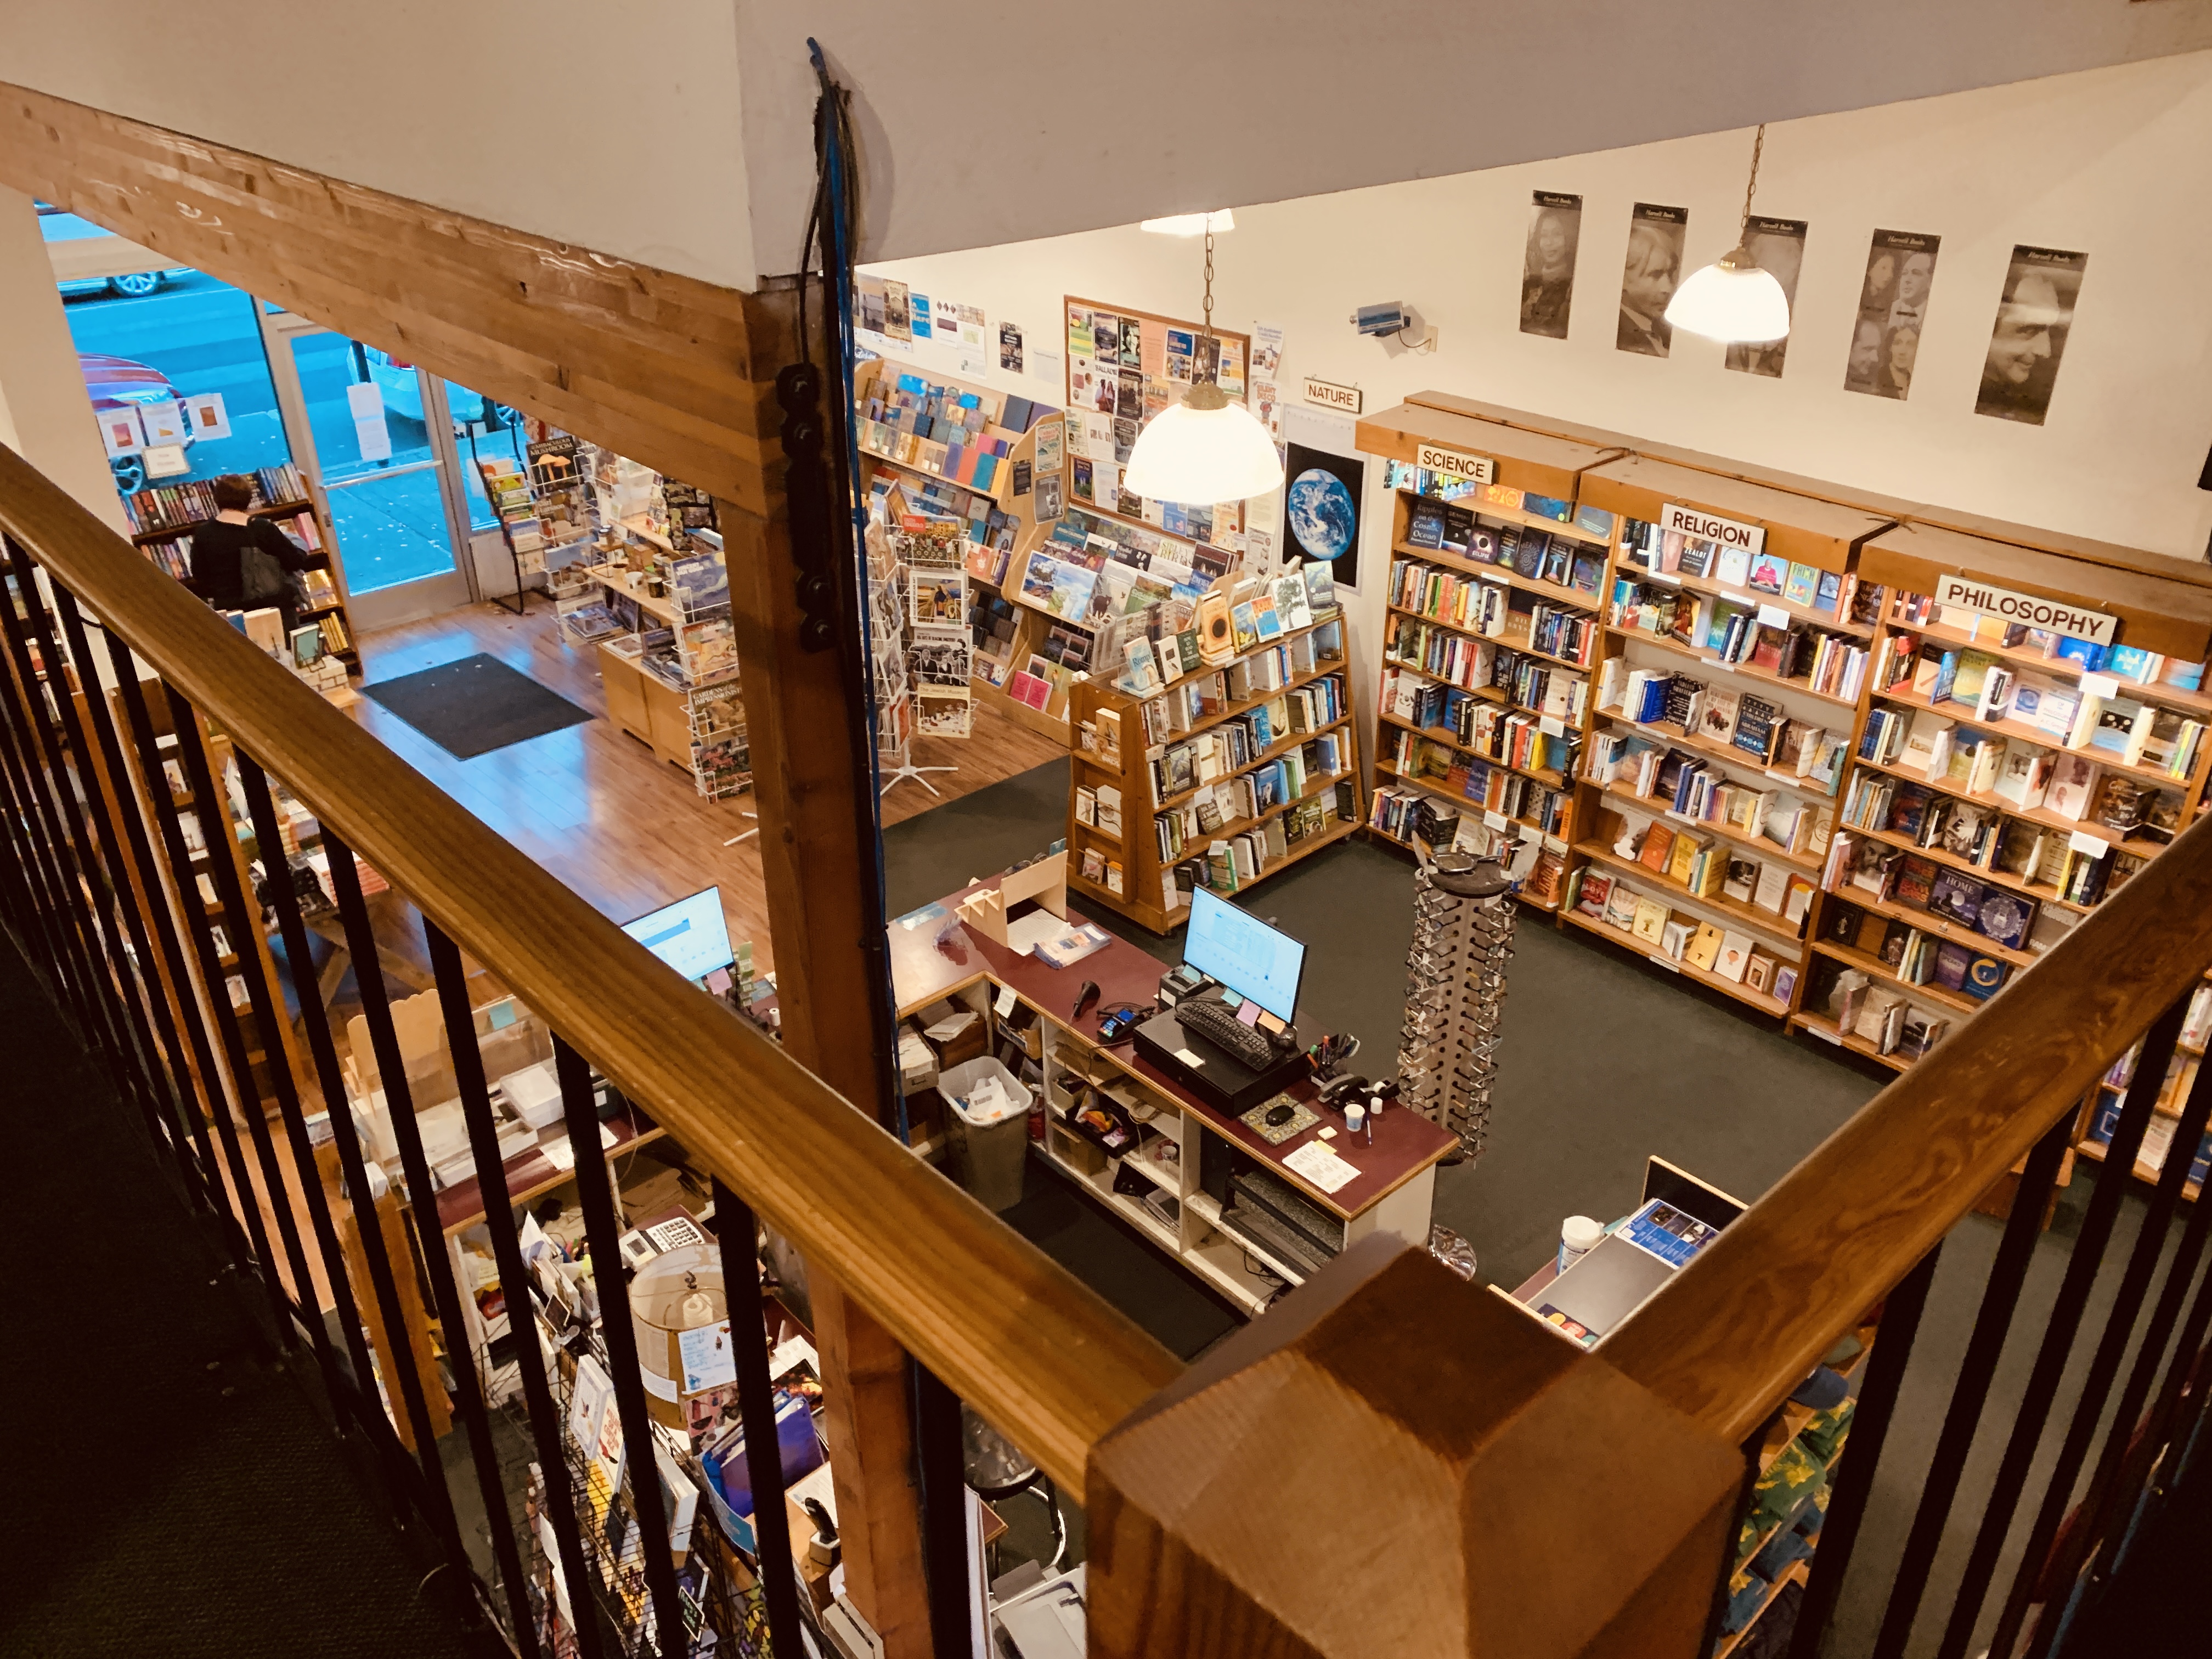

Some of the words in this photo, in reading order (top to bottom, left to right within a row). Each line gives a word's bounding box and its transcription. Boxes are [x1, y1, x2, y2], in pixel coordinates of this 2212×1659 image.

[1256, 392, 1276, 402] DISCO
[1308, 383, 1354, 407] NATURE
[531, 442, 573, 456] MUSHROOM
[1423, 450, 1485, 478] SCIENCE
[1417, 503, 1443, 515] Ripples
[1413, 521, 1440, 533] Cosmic
[1672, 511, 1751, 547] RELIGION
[1413, 529, 1437, 540] Ocean
[1160, 549, 1193, 567] BIRDS
[1684, 547, 1707, 560] ZEALOT
[1792, 563, 1815, 582] FAITH
[1948, 583, 2104, 637] PHILOSOPHY
[1508, 621, 1531, 633] BRYS
[1515, 616, 1532, 625] BIL
[692, 687, 723, 700] GARDENS
[694, 687, 742, 706] IMPRESSIONIST
[1741, 721, 1767, 734] ABRAHAM
[1102, 756, 1120, 766] BIRDS
[1945, 876, 1975, 895] HOME
